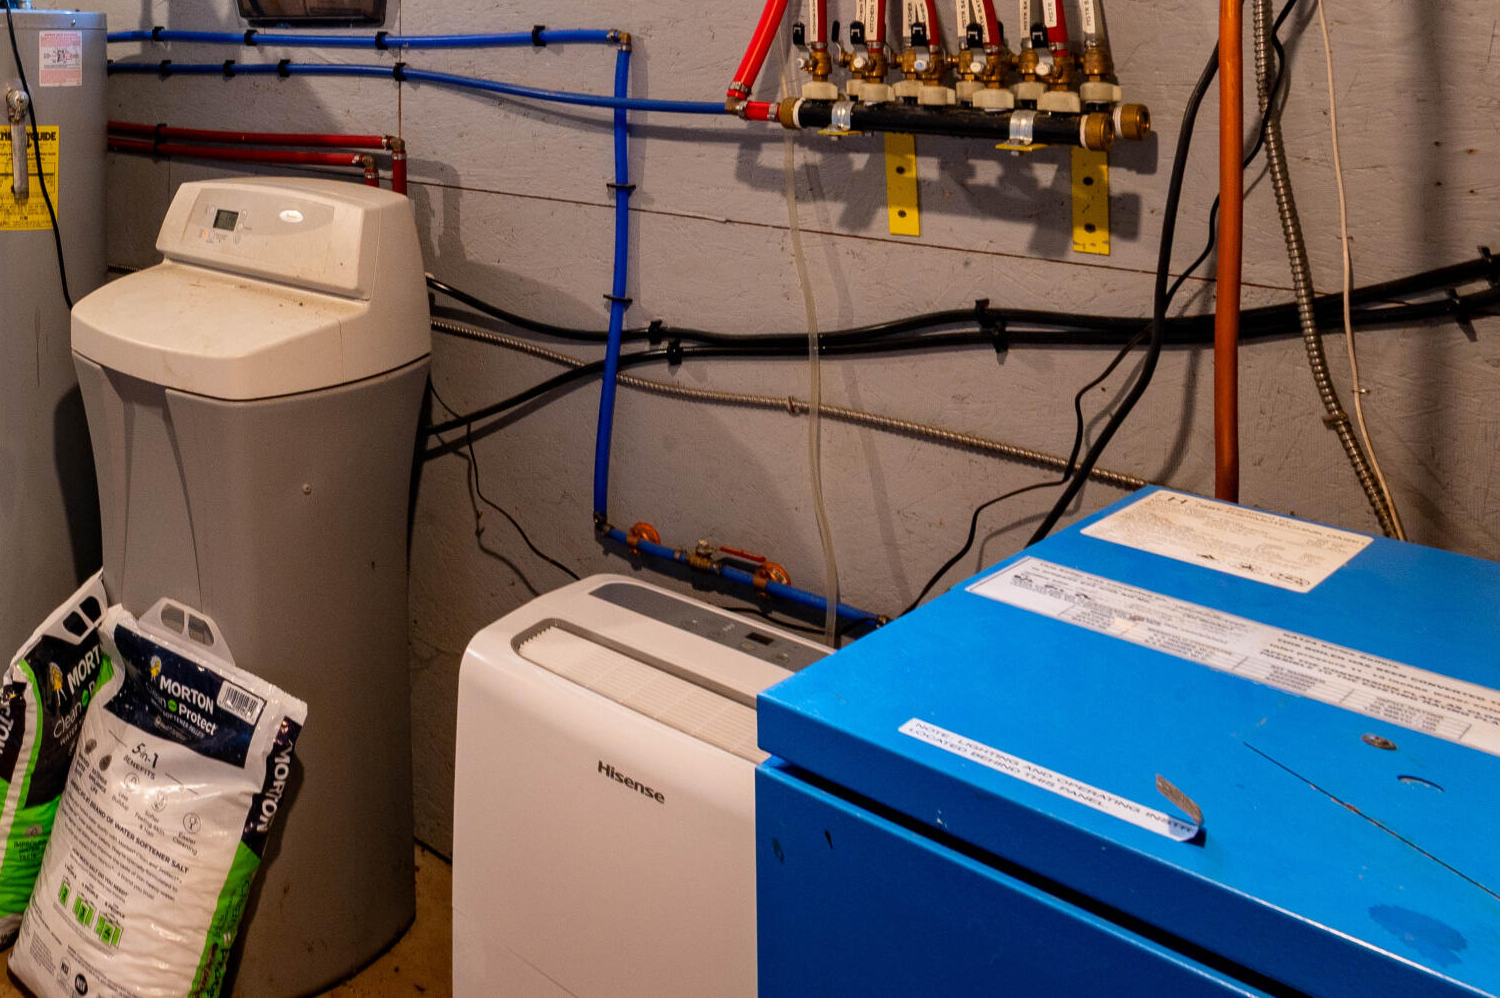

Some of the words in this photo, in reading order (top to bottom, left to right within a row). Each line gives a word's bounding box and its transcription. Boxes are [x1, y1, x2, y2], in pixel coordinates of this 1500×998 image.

[66, 647, 103, 694] MORT
[1410, 675, 1484, 703] CONVERTED
[160, 675, 214, 715] MORTON
[53, 704, 83, 740] Clean
[178, 702, 218, 736] Protect
[123, 754, 156, 780] BENEFITS
[906, 726, 969, 753] LOCATED
[969, 750, 1022, 774] BEHIND
[1022, 771, 1056, 787] THIS
[955, 738, 1021, 766] LIGHTING
[1022, 764, 1054, 779] AND
[1053, 776, 1143, 813] OPERATING
[256, 739, 294, 833] MORTON
[597, 759, 666, 805] Hisense
[112, 823, 136, 840] WATER
[134, 838, 172, 864] SOFTENER
[171, 860, 189, 874] SALT
[172, 837, 198, 856] Cleaning
